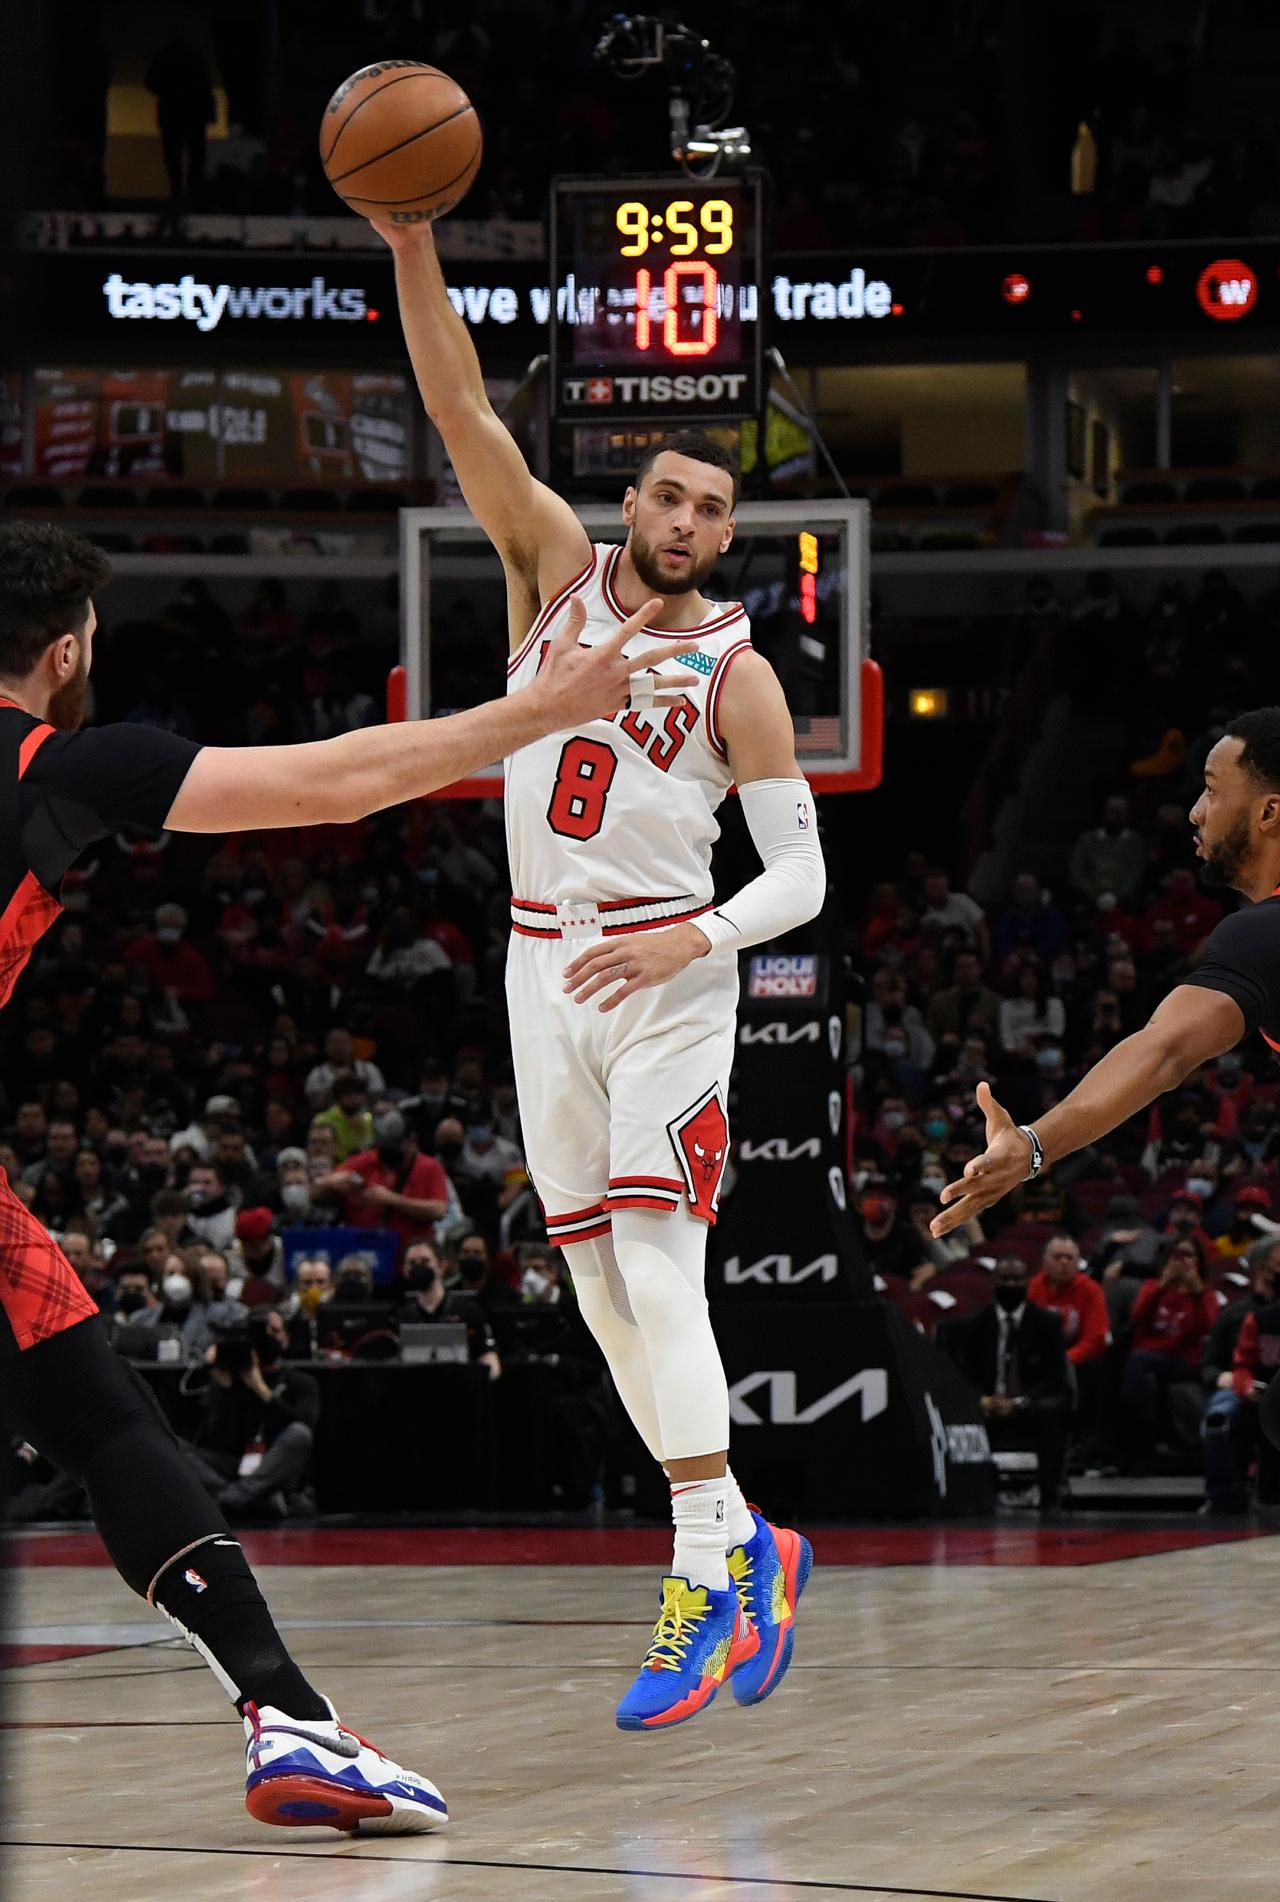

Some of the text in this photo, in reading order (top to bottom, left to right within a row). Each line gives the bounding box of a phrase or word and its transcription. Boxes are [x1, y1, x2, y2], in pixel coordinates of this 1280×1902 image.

[616, 200, 733, 257] 9:59
[103, 273, 381, 332] tastyworks.
[635, 260, 717, 356] 10
[771, 268, 905, 321] trade.
[617, 374, 749, 402] TISSOT
[546, 735, 619, 843] 8
[754, 976, 816, 995] MOLY
[724, 1253, 838, 1285] KIA
